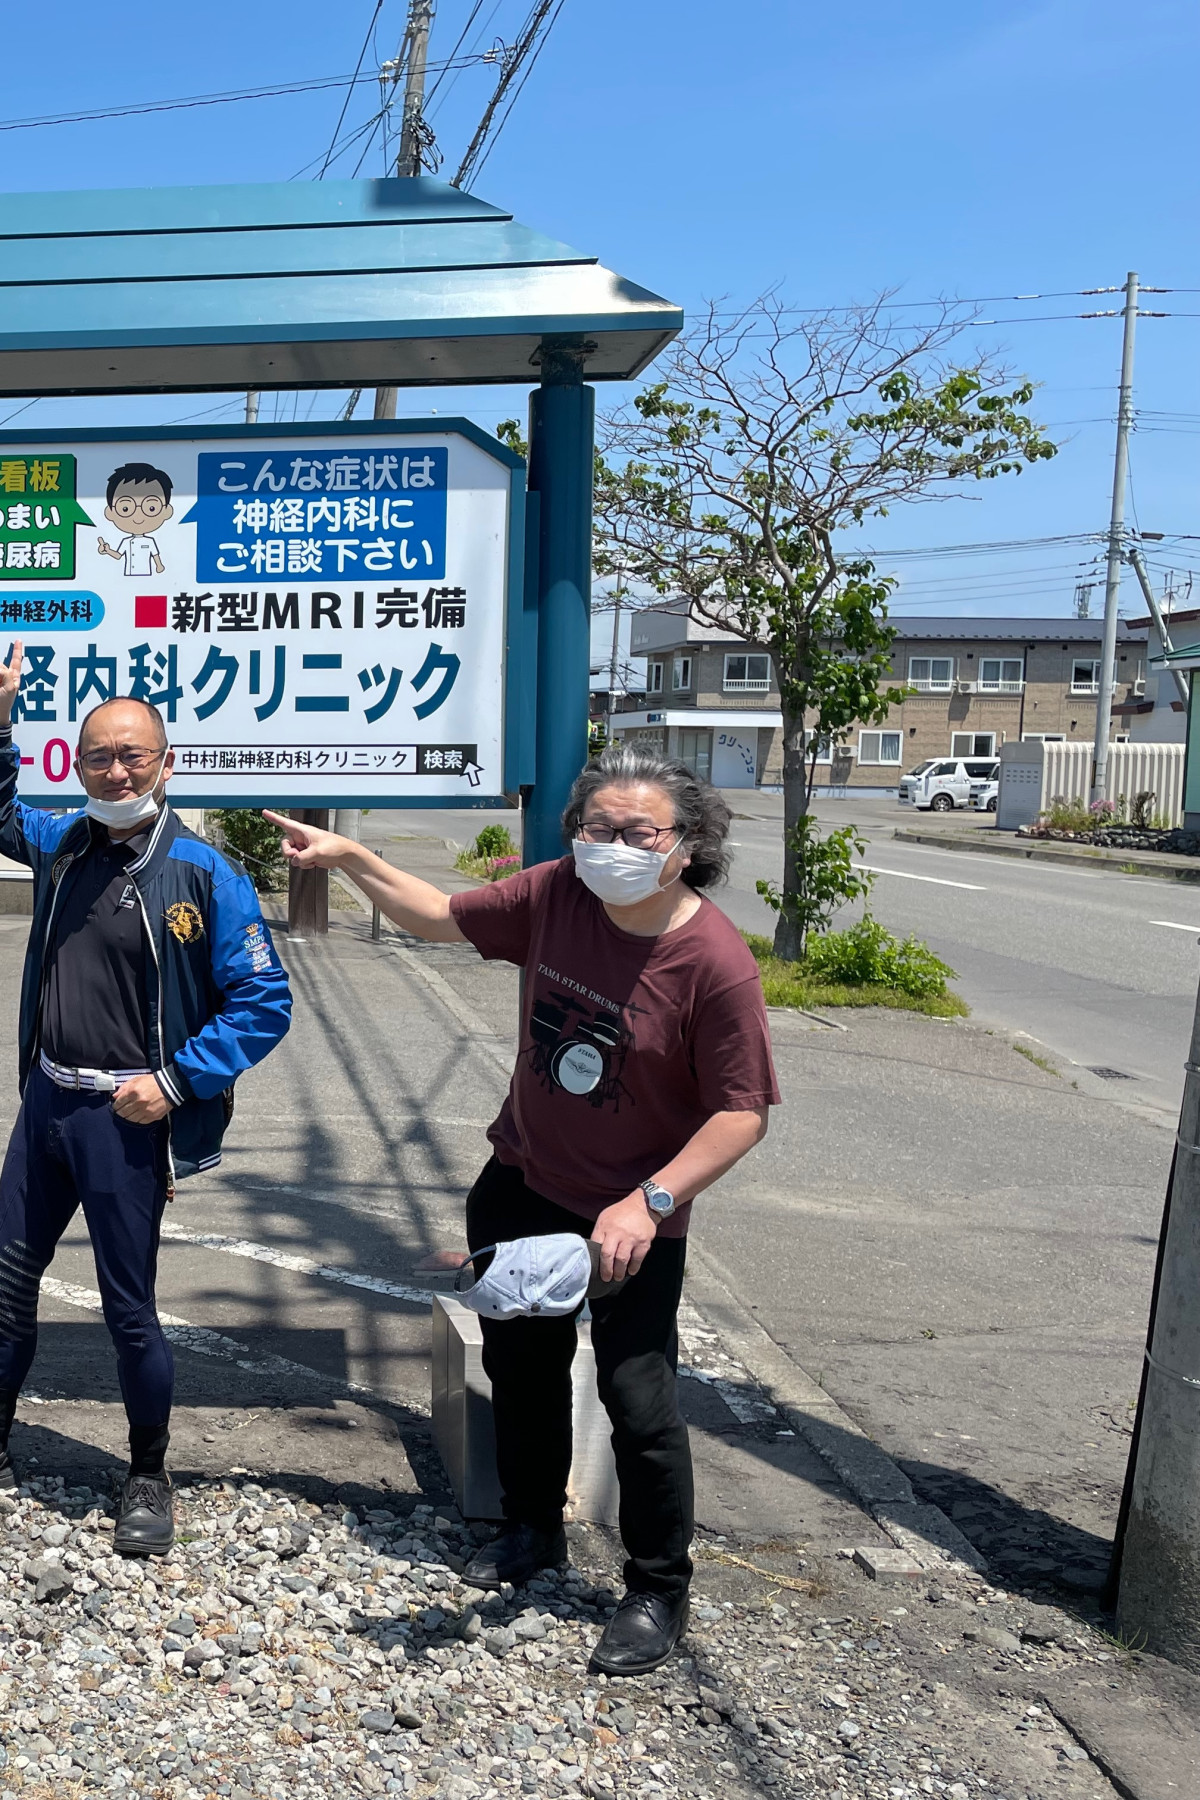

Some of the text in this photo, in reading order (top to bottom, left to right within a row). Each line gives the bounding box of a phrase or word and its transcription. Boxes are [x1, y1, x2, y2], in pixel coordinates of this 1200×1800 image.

[217, 456, 436, 492] こんな症状は
[232, 497, 415, 534] 神経内科に
[216, 538, 434, 574] ご相談下さい
[171, 586, 466, 633] 新型MRI完備
[182, 749, 463, 770] 中村脳神経内科クリニック 検索
[538, 963, 620, 1014] TAMA STAR DRUMS
